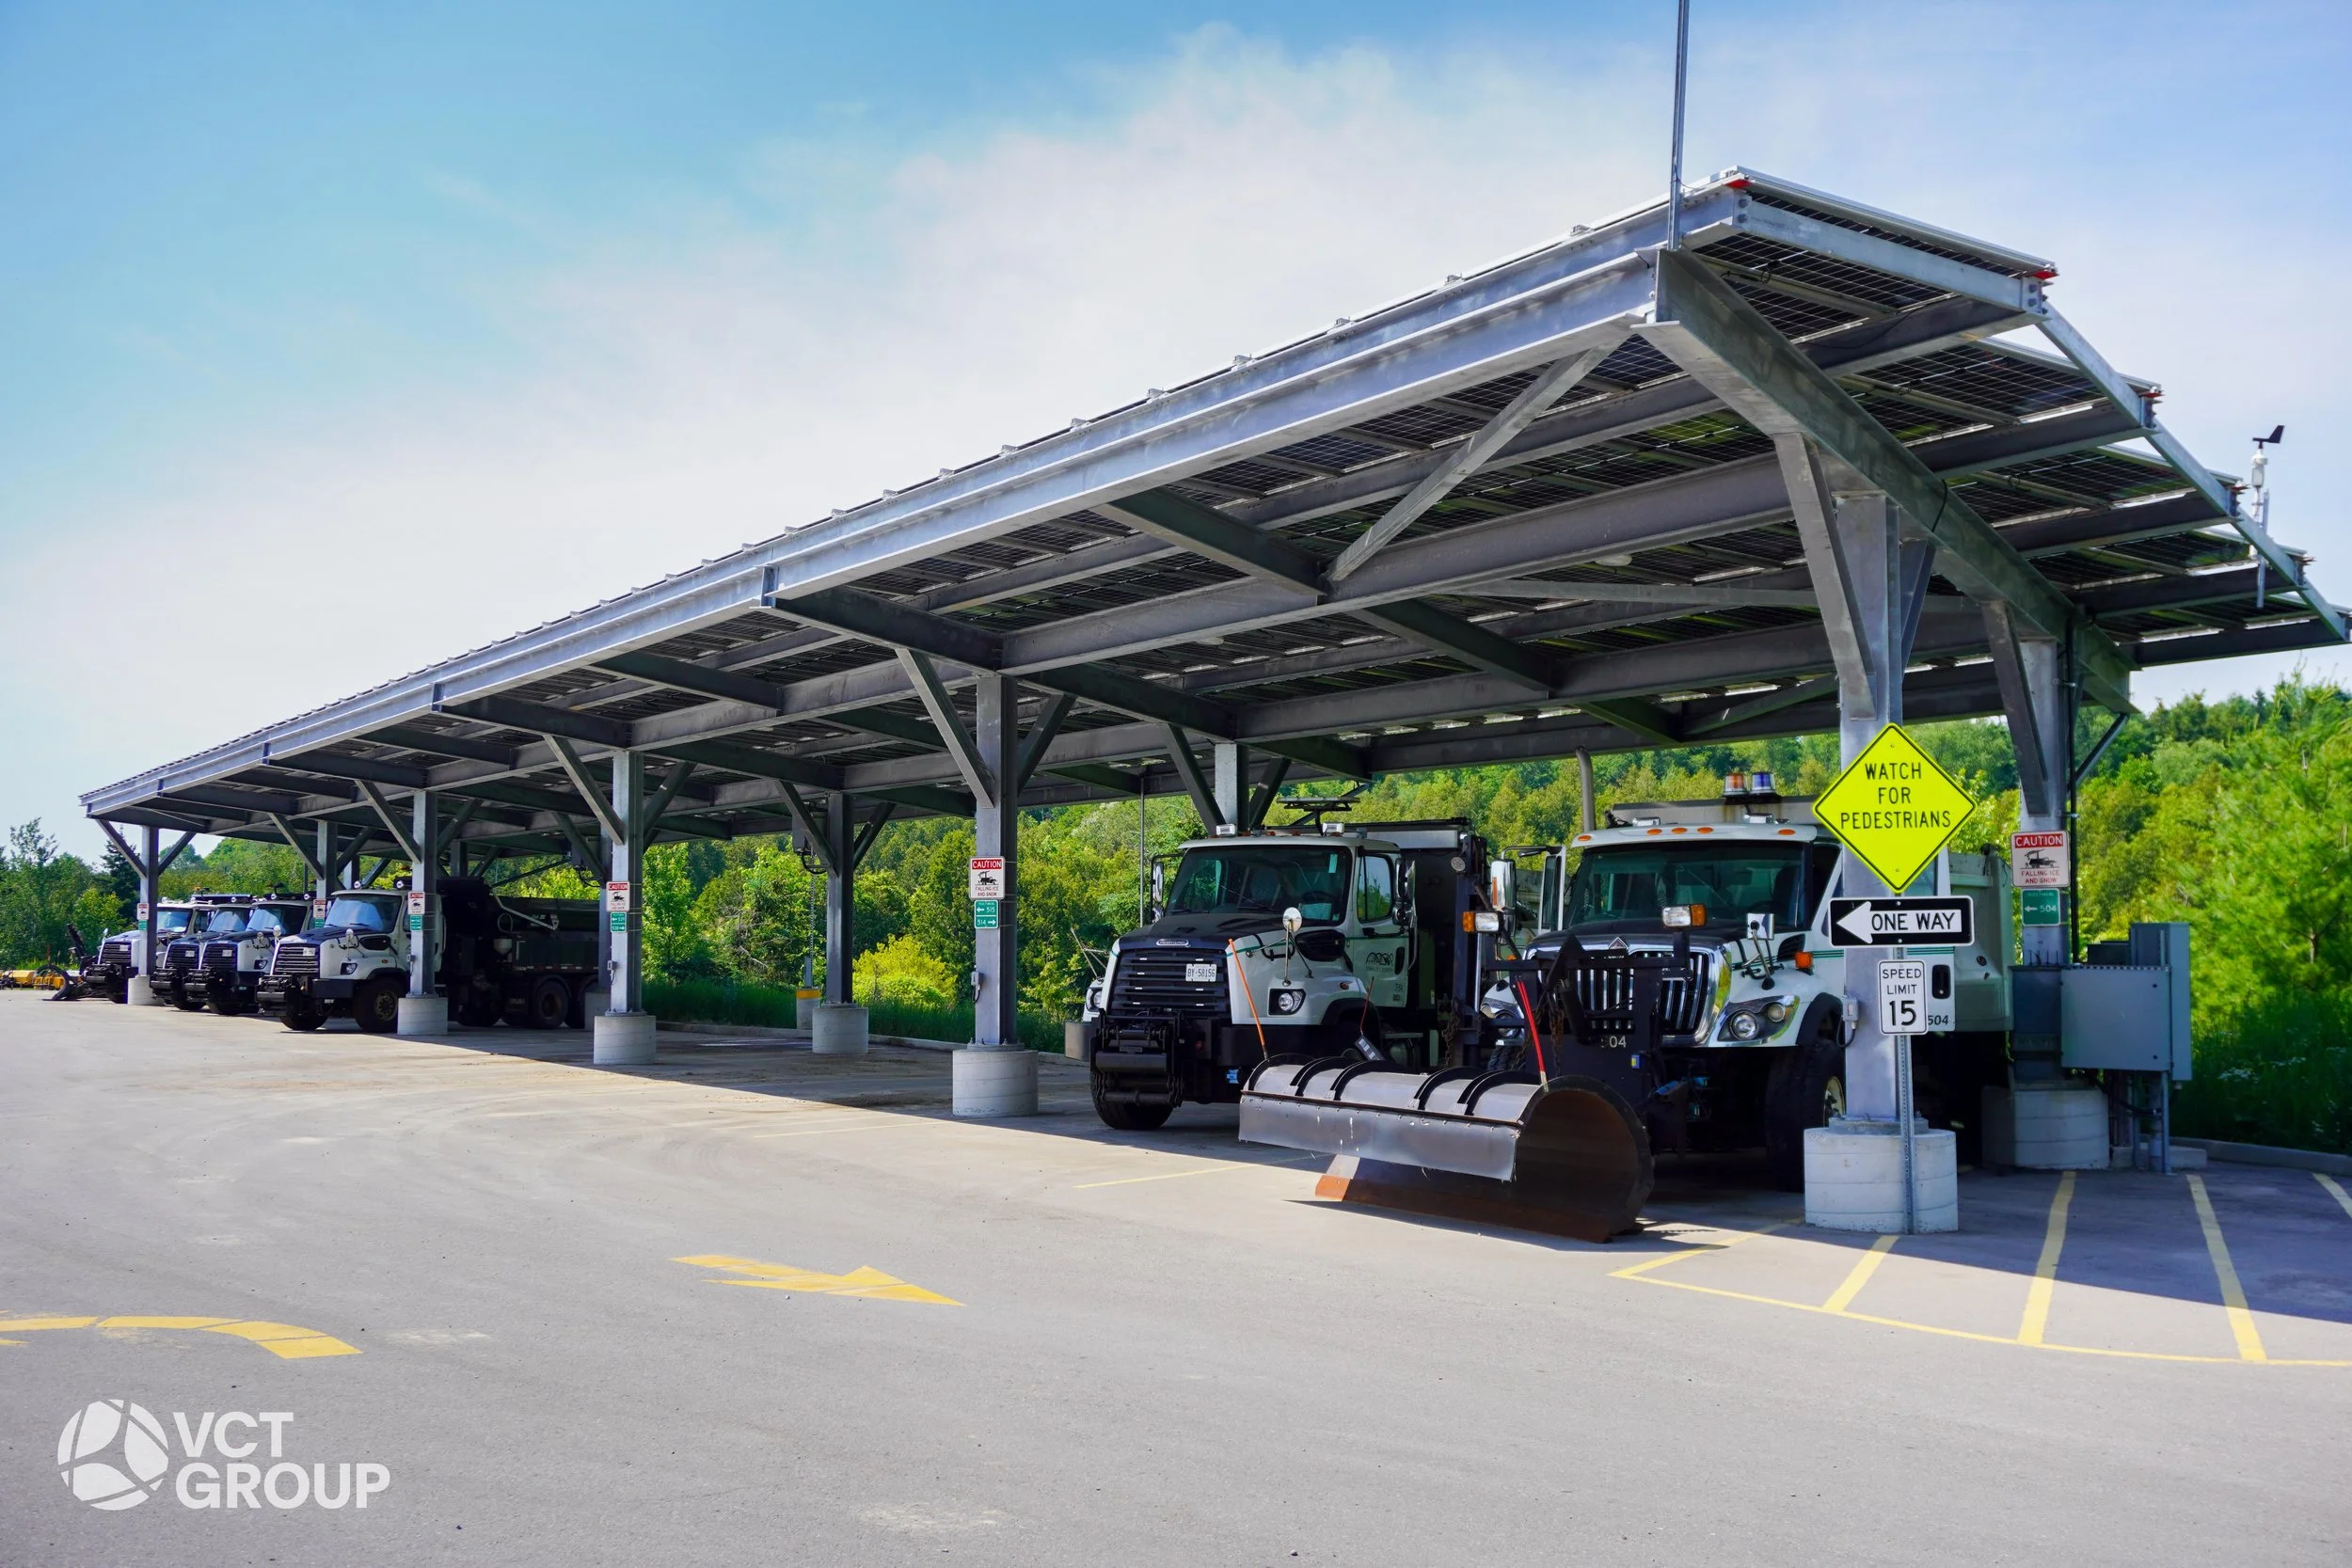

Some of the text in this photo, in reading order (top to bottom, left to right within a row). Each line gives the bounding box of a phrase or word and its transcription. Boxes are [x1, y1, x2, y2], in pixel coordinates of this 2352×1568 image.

[1865, 763, 1922, 780] WATCH
[1878, 787, 1911, 804] FOR
[1840, 810, 1950, 830] PEDESTRIANS
[2015, 835, 2063, 847] CAUTION
[972, 860, 1002, 869] CAUTION
[2021, 869, 2048, 878] FALLING
[1871, 912, 1956, 931] ONE WAY
[1883, 968, 1922, 979] SPEED
[1886, 984, 1917, 995] LIMIT
[1889, 1000, 1916, 1026] 15
[1928, 1015, 1948, 1025] 504
[1601, 1036, 1627, 1048] 04
